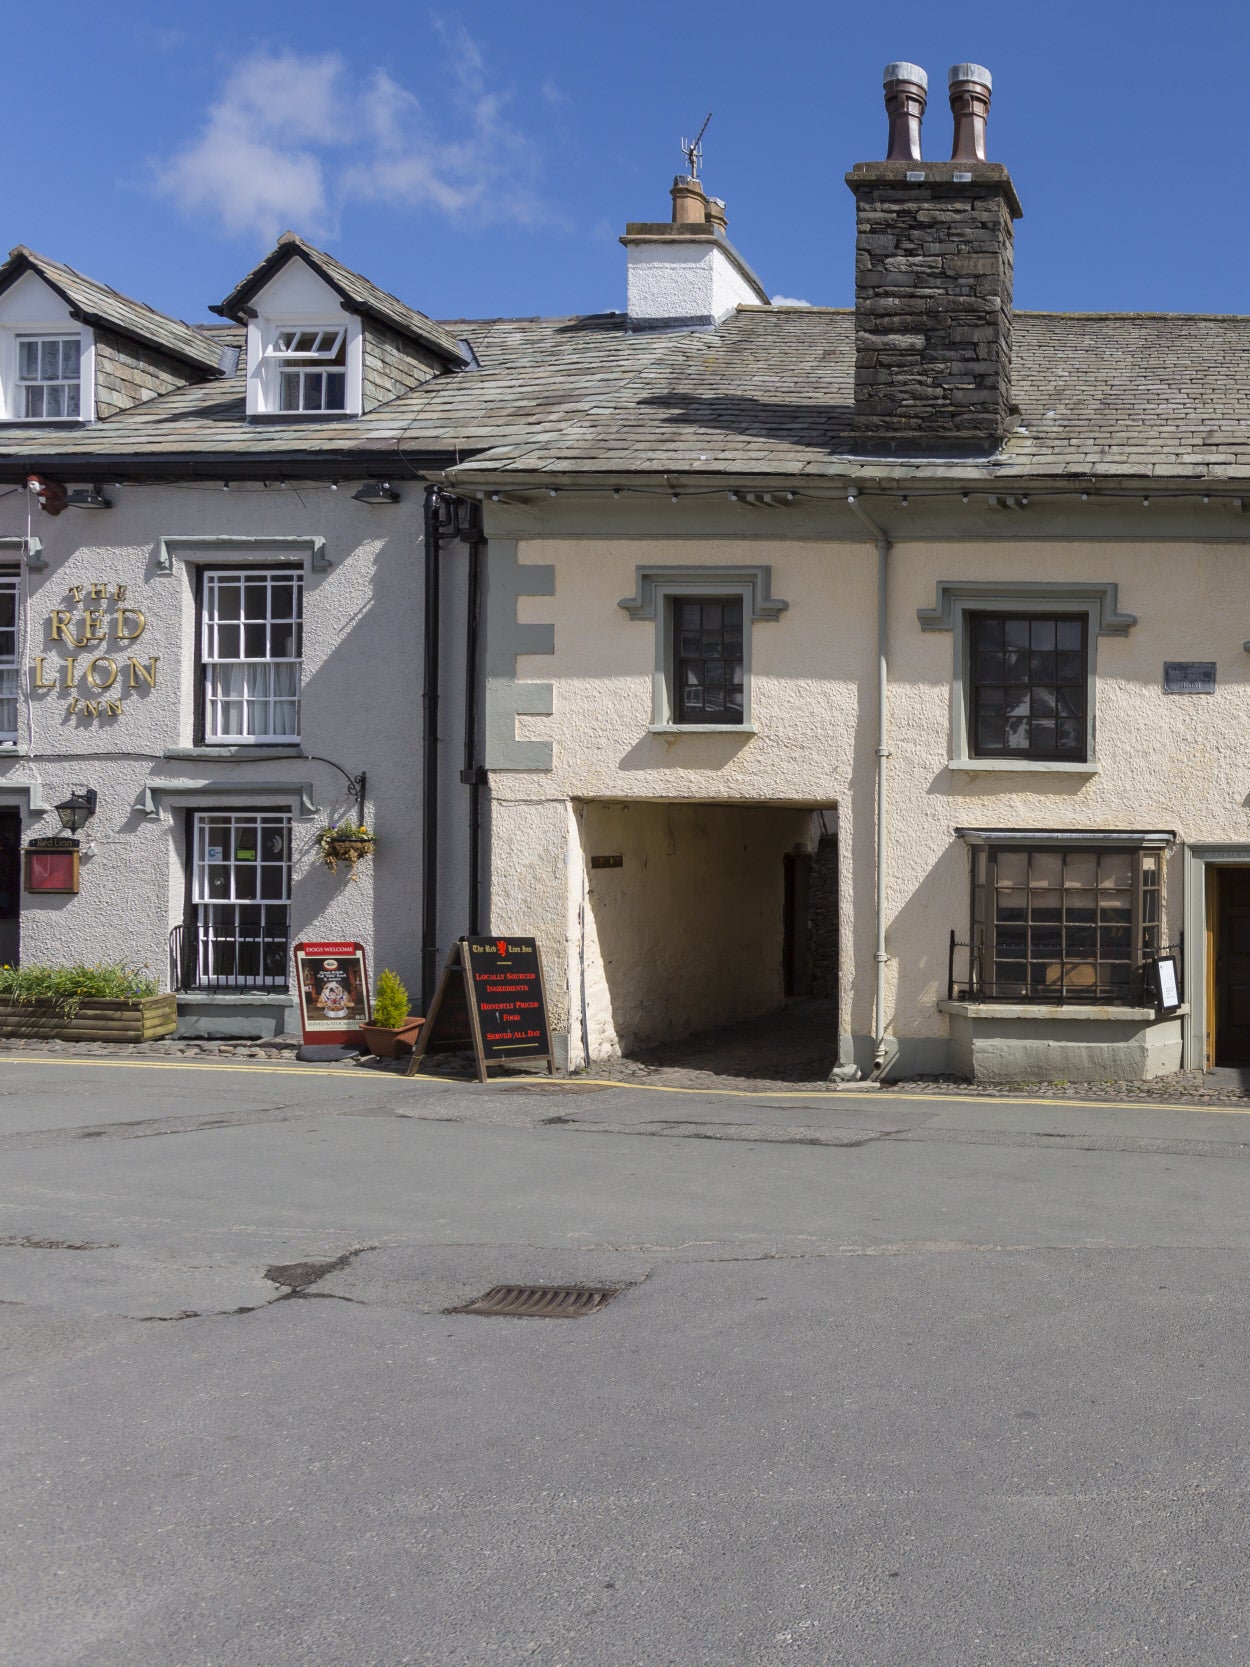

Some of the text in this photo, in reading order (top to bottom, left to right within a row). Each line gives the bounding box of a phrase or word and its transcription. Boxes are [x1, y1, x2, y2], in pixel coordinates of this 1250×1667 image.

[68, 583, 127, 603] THE
[48, 608, 146, 647] RED
[33, 656, 160, 689] LION
[69, 697, 124, 717] INN
[37, 838, 73, 847] Red Lion
[472, 945, 484, 953] The
